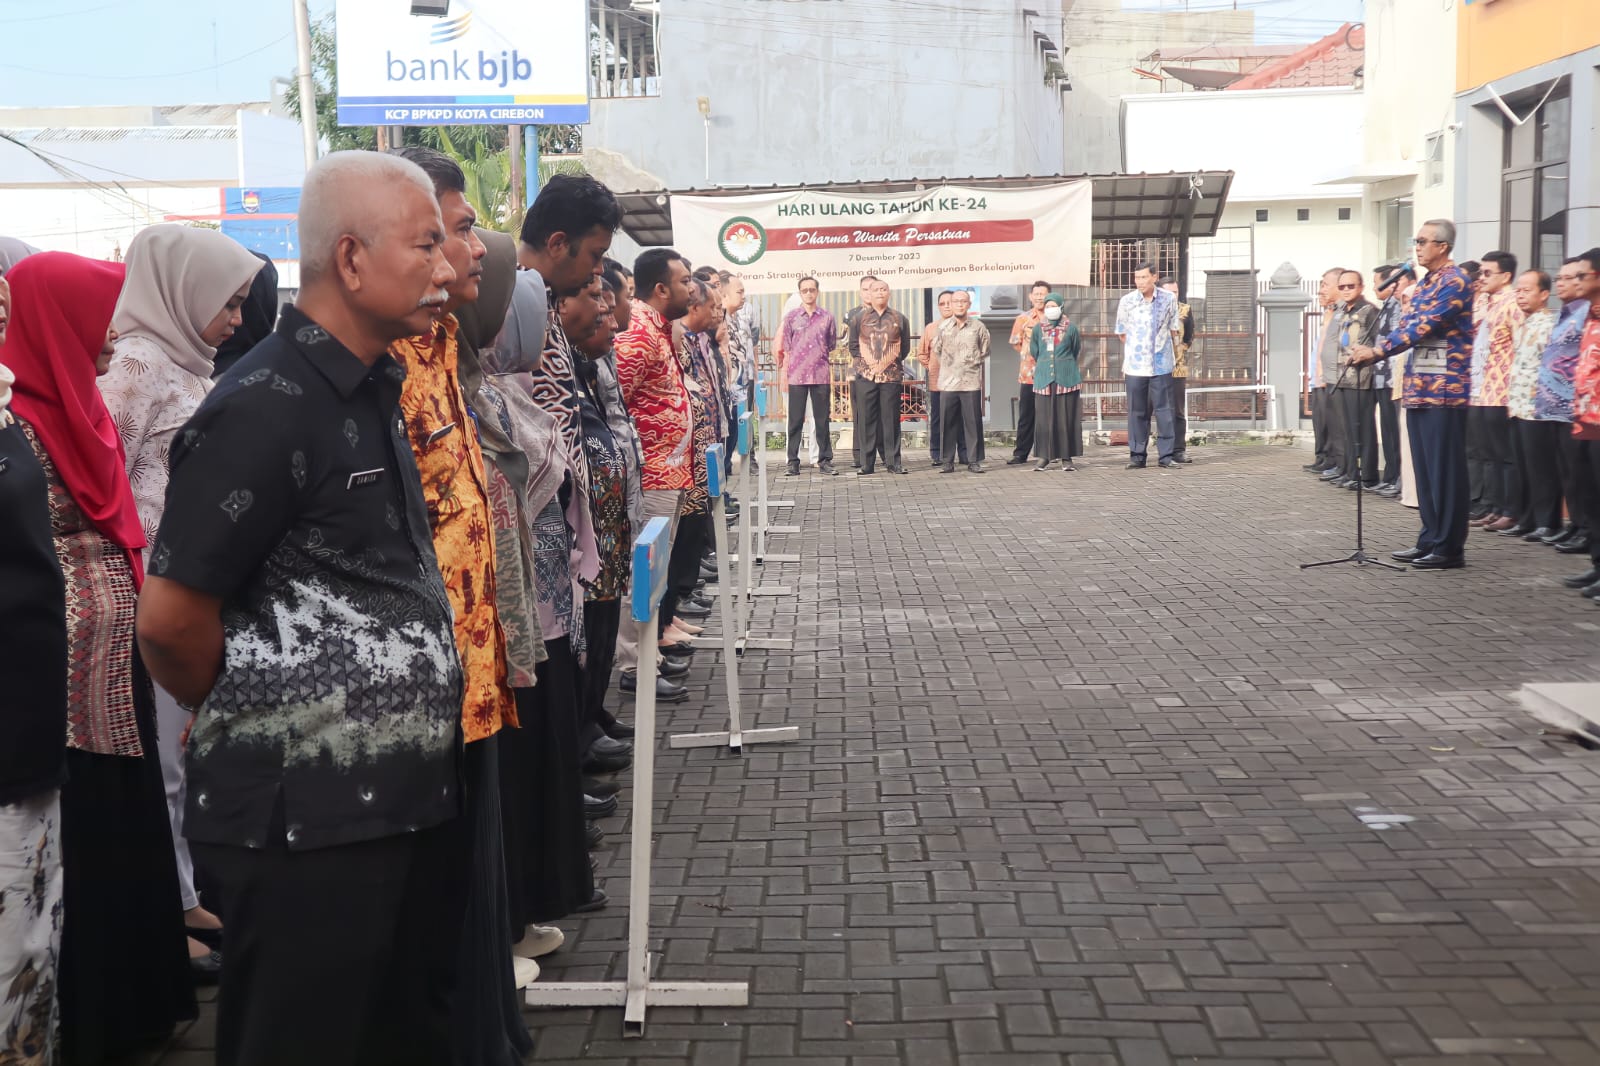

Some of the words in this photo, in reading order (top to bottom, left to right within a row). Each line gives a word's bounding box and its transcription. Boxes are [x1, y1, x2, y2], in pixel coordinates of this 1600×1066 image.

[386, 49, 471, 82] bank
[478, 49, 532, 88] bjb
[385, 109, 408, 120] KCP
[411, 109, 453, 120] BPKPD
[455, 109, 488, 120] KOTA
[490, 108, 544, 119] CIREBON
[777, 203, 815, 217] HARI
[820, 202, 876, 216] ULANG
[879, 198, 935, 215] TAHUN
[939, 197, 988, 212] KE-24
[795, 231, 850, 246] Dharma
[853, 229, 901, 244] Wanita
[904, 227, 971, 243] Persatuan
[849, 254, 854, 262] 7
[856, 252, 896, 261] Desember
[898, 252, 921, 261] 2023
[811, 267, 864, 279] Perempuan
[866, 266, 897, 277] dalam
[898, 264, 967, 276] Pembangunan
[969, 262, 1036, 275] Berkelanjutan
